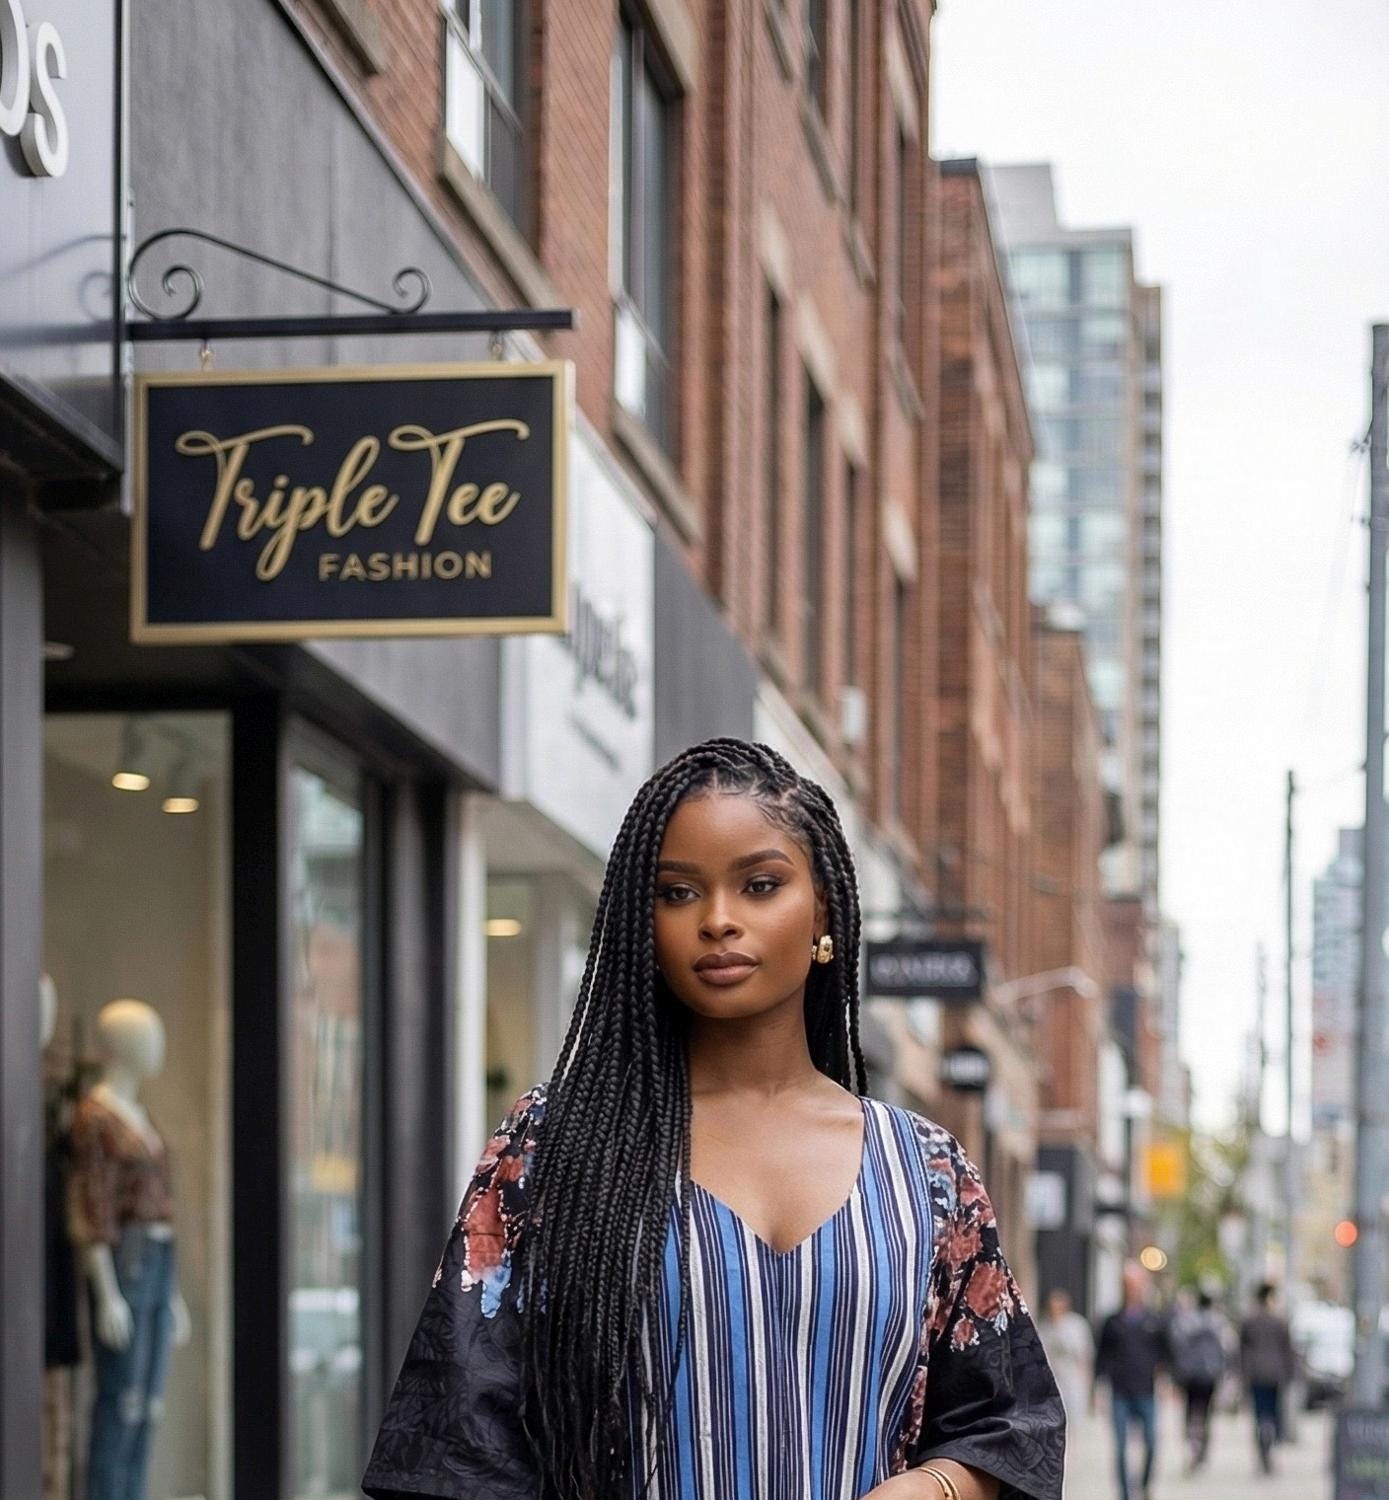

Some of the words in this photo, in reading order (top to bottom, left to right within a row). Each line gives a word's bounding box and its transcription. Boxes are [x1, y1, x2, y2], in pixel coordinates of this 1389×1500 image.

[175, 424, 399, 582] Triple
[388, 418, 530, 546] Tee
[318, 550, 493, 581] FASHION
